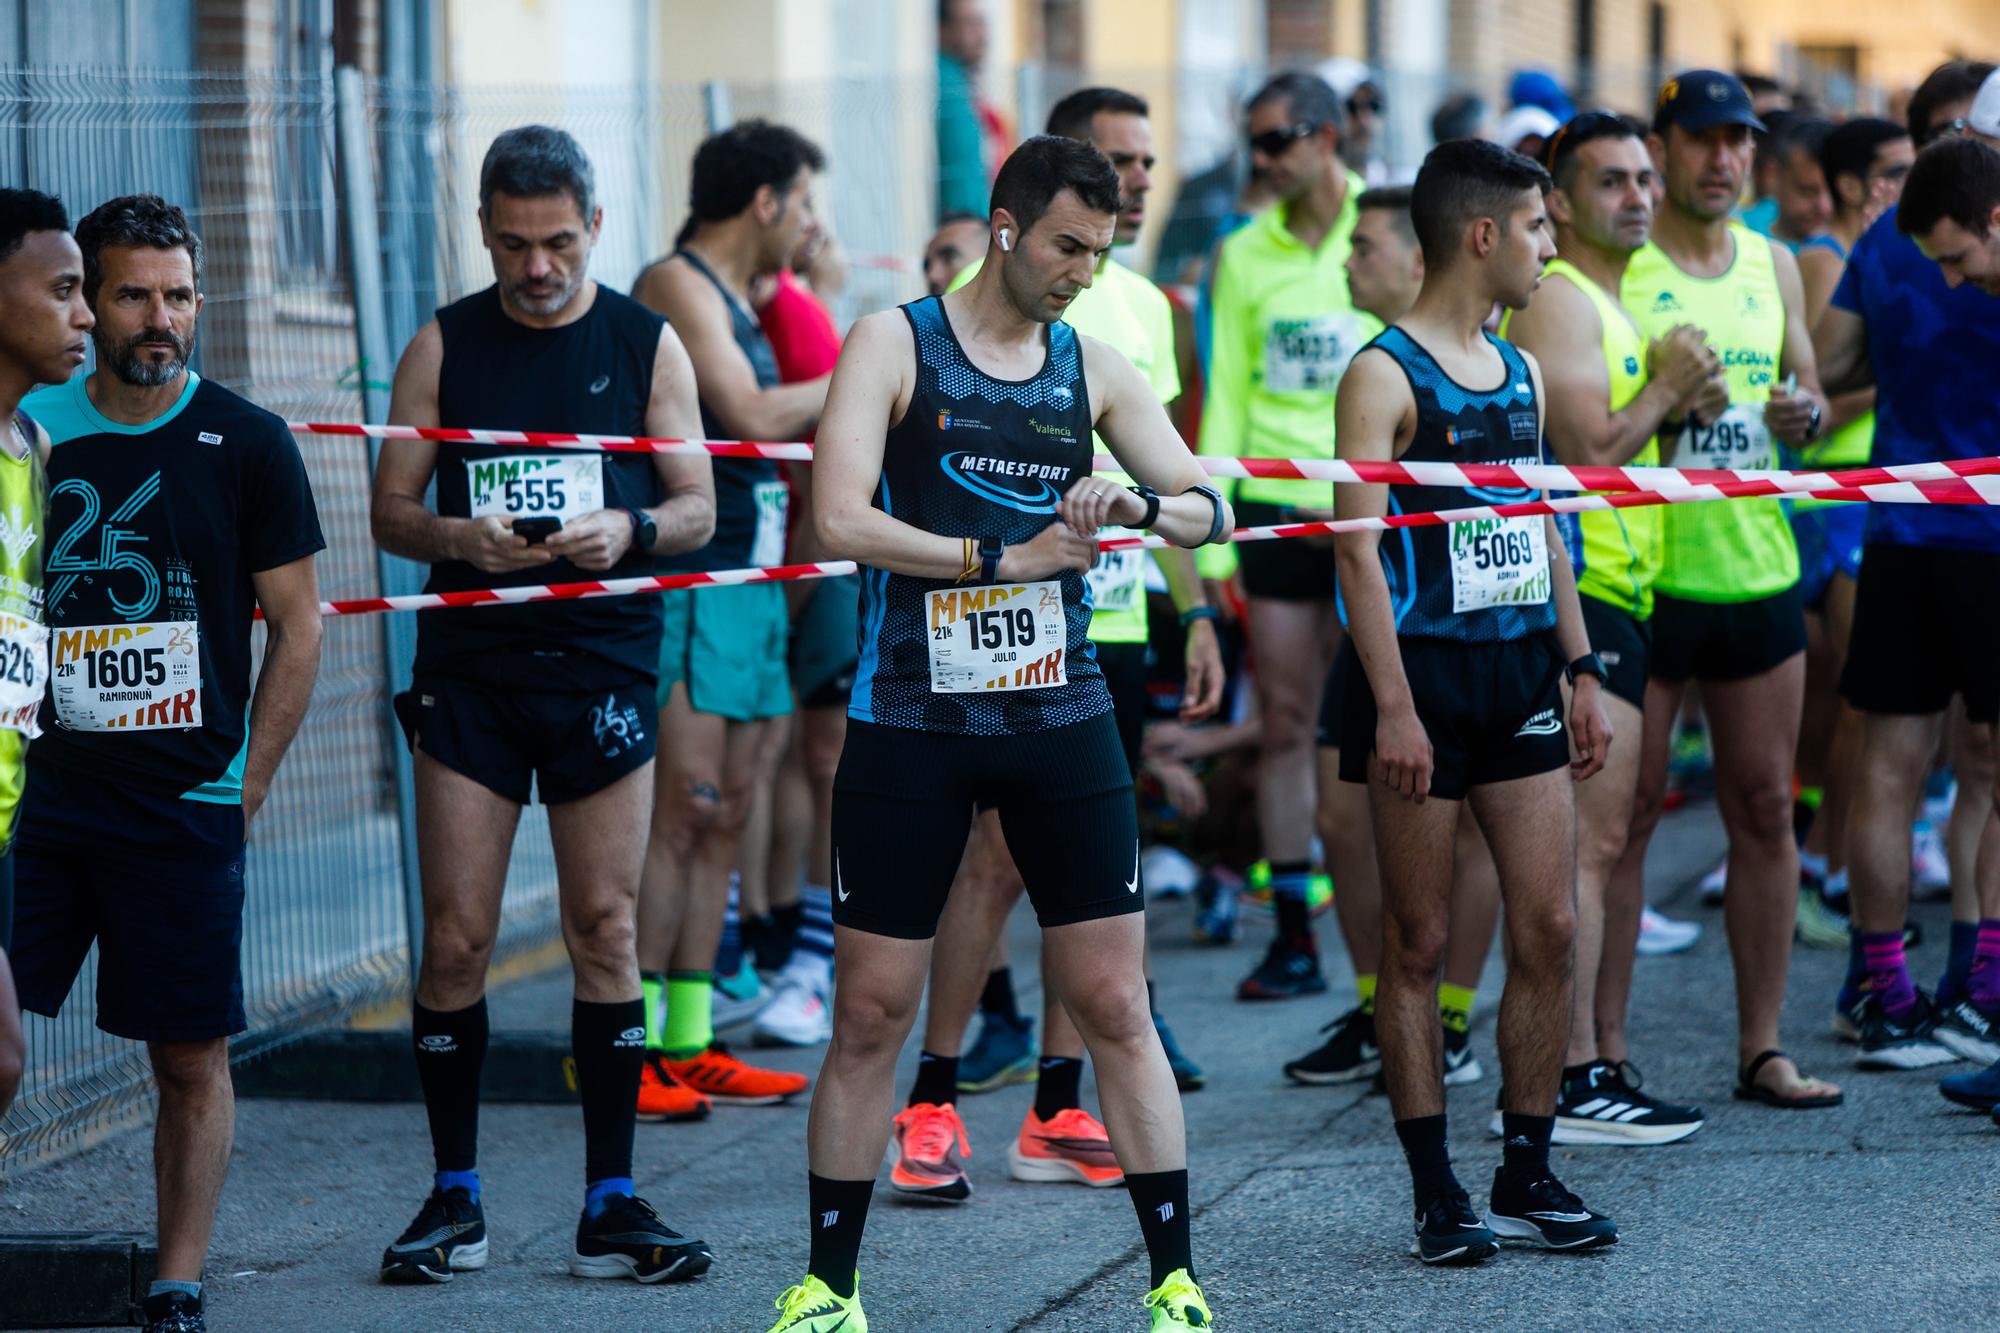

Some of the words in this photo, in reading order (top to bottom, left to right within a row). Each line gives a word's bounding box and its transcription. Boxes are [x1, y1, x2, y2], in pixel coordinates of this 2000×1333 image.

[1035, 424, 1071, 437] València
[960, 456, 1070, 481] METAESPORT
[505, 479, 566, 512] 555
[1474, 531, 1532, 569] 5069
[934, 626, 952, 640] 21k
[965, 608, 1035, 650] 1519
[992, 652, 1016, 663] JULIO
[58, 664, 75, 677] 21k
[84, 648, 166, 688] 1605
[100, 688, 152, 702] RAMIRONUÑ
